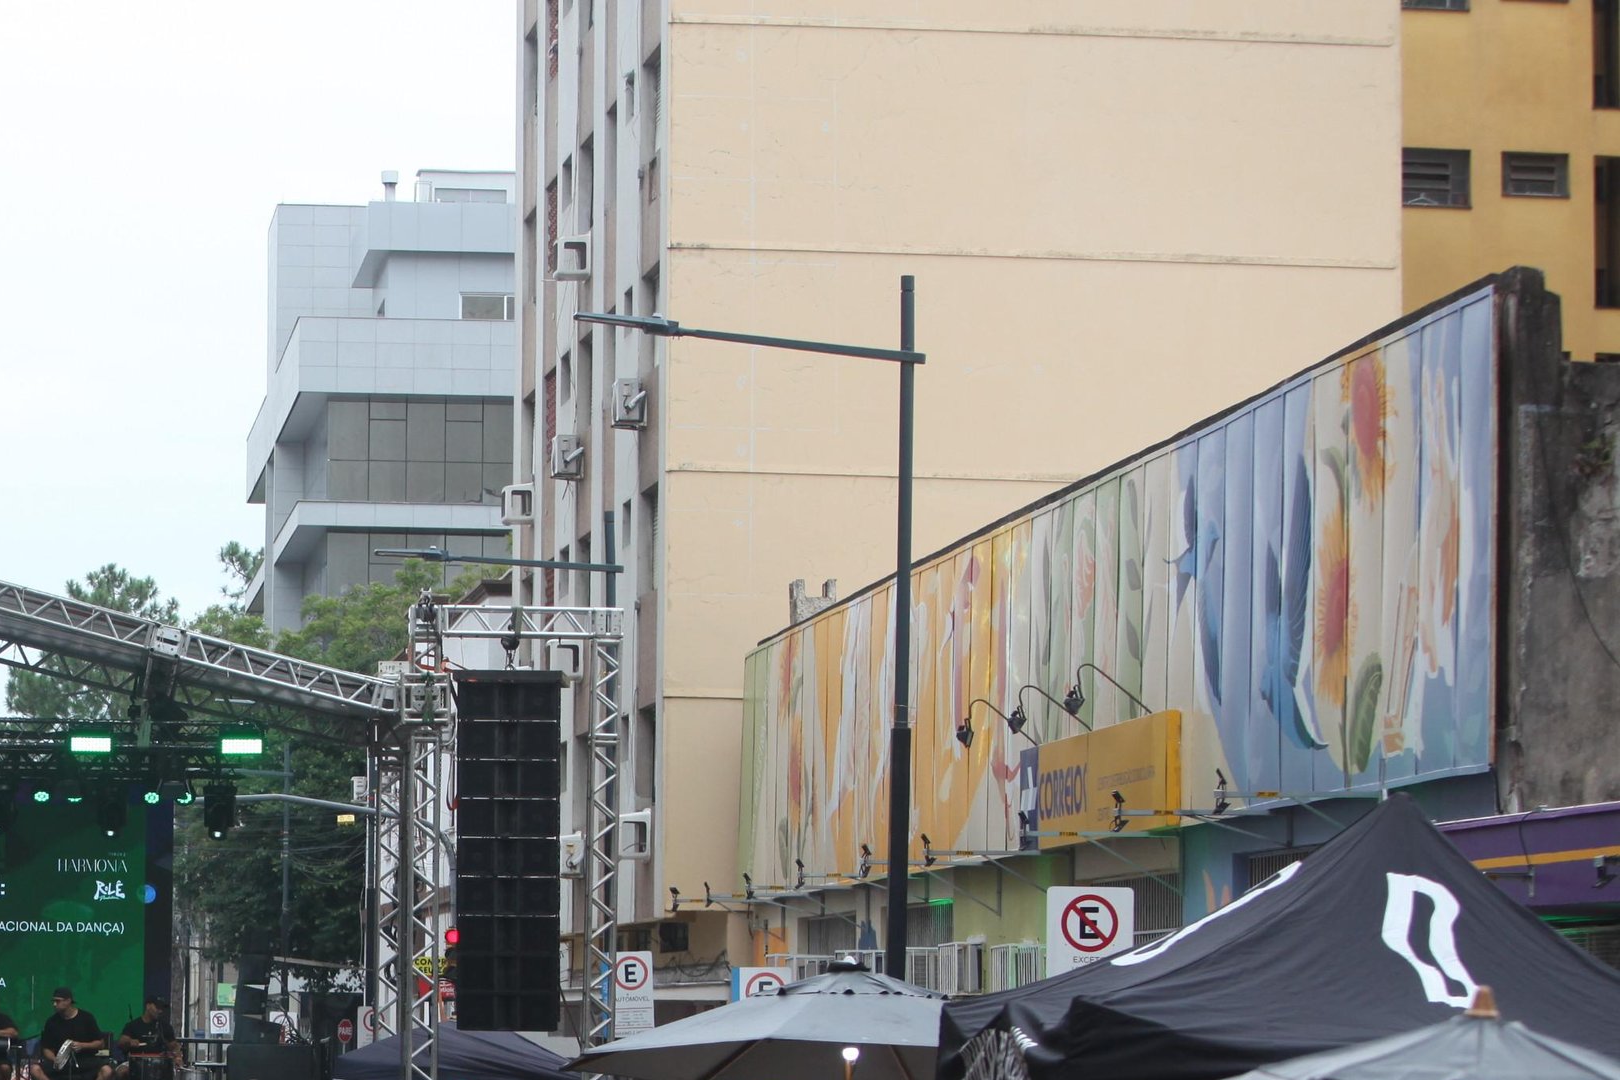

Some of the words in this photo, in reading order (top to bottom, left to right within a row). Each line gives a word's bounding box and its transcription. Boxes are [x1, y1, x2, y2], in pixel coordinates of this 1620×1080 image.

[56, 921, 74, 933] DA
[76, 922, 125, 936] DANÇA)
[624, 964, 638, 983] E
[338, 1026, 352, 1036] PARE
